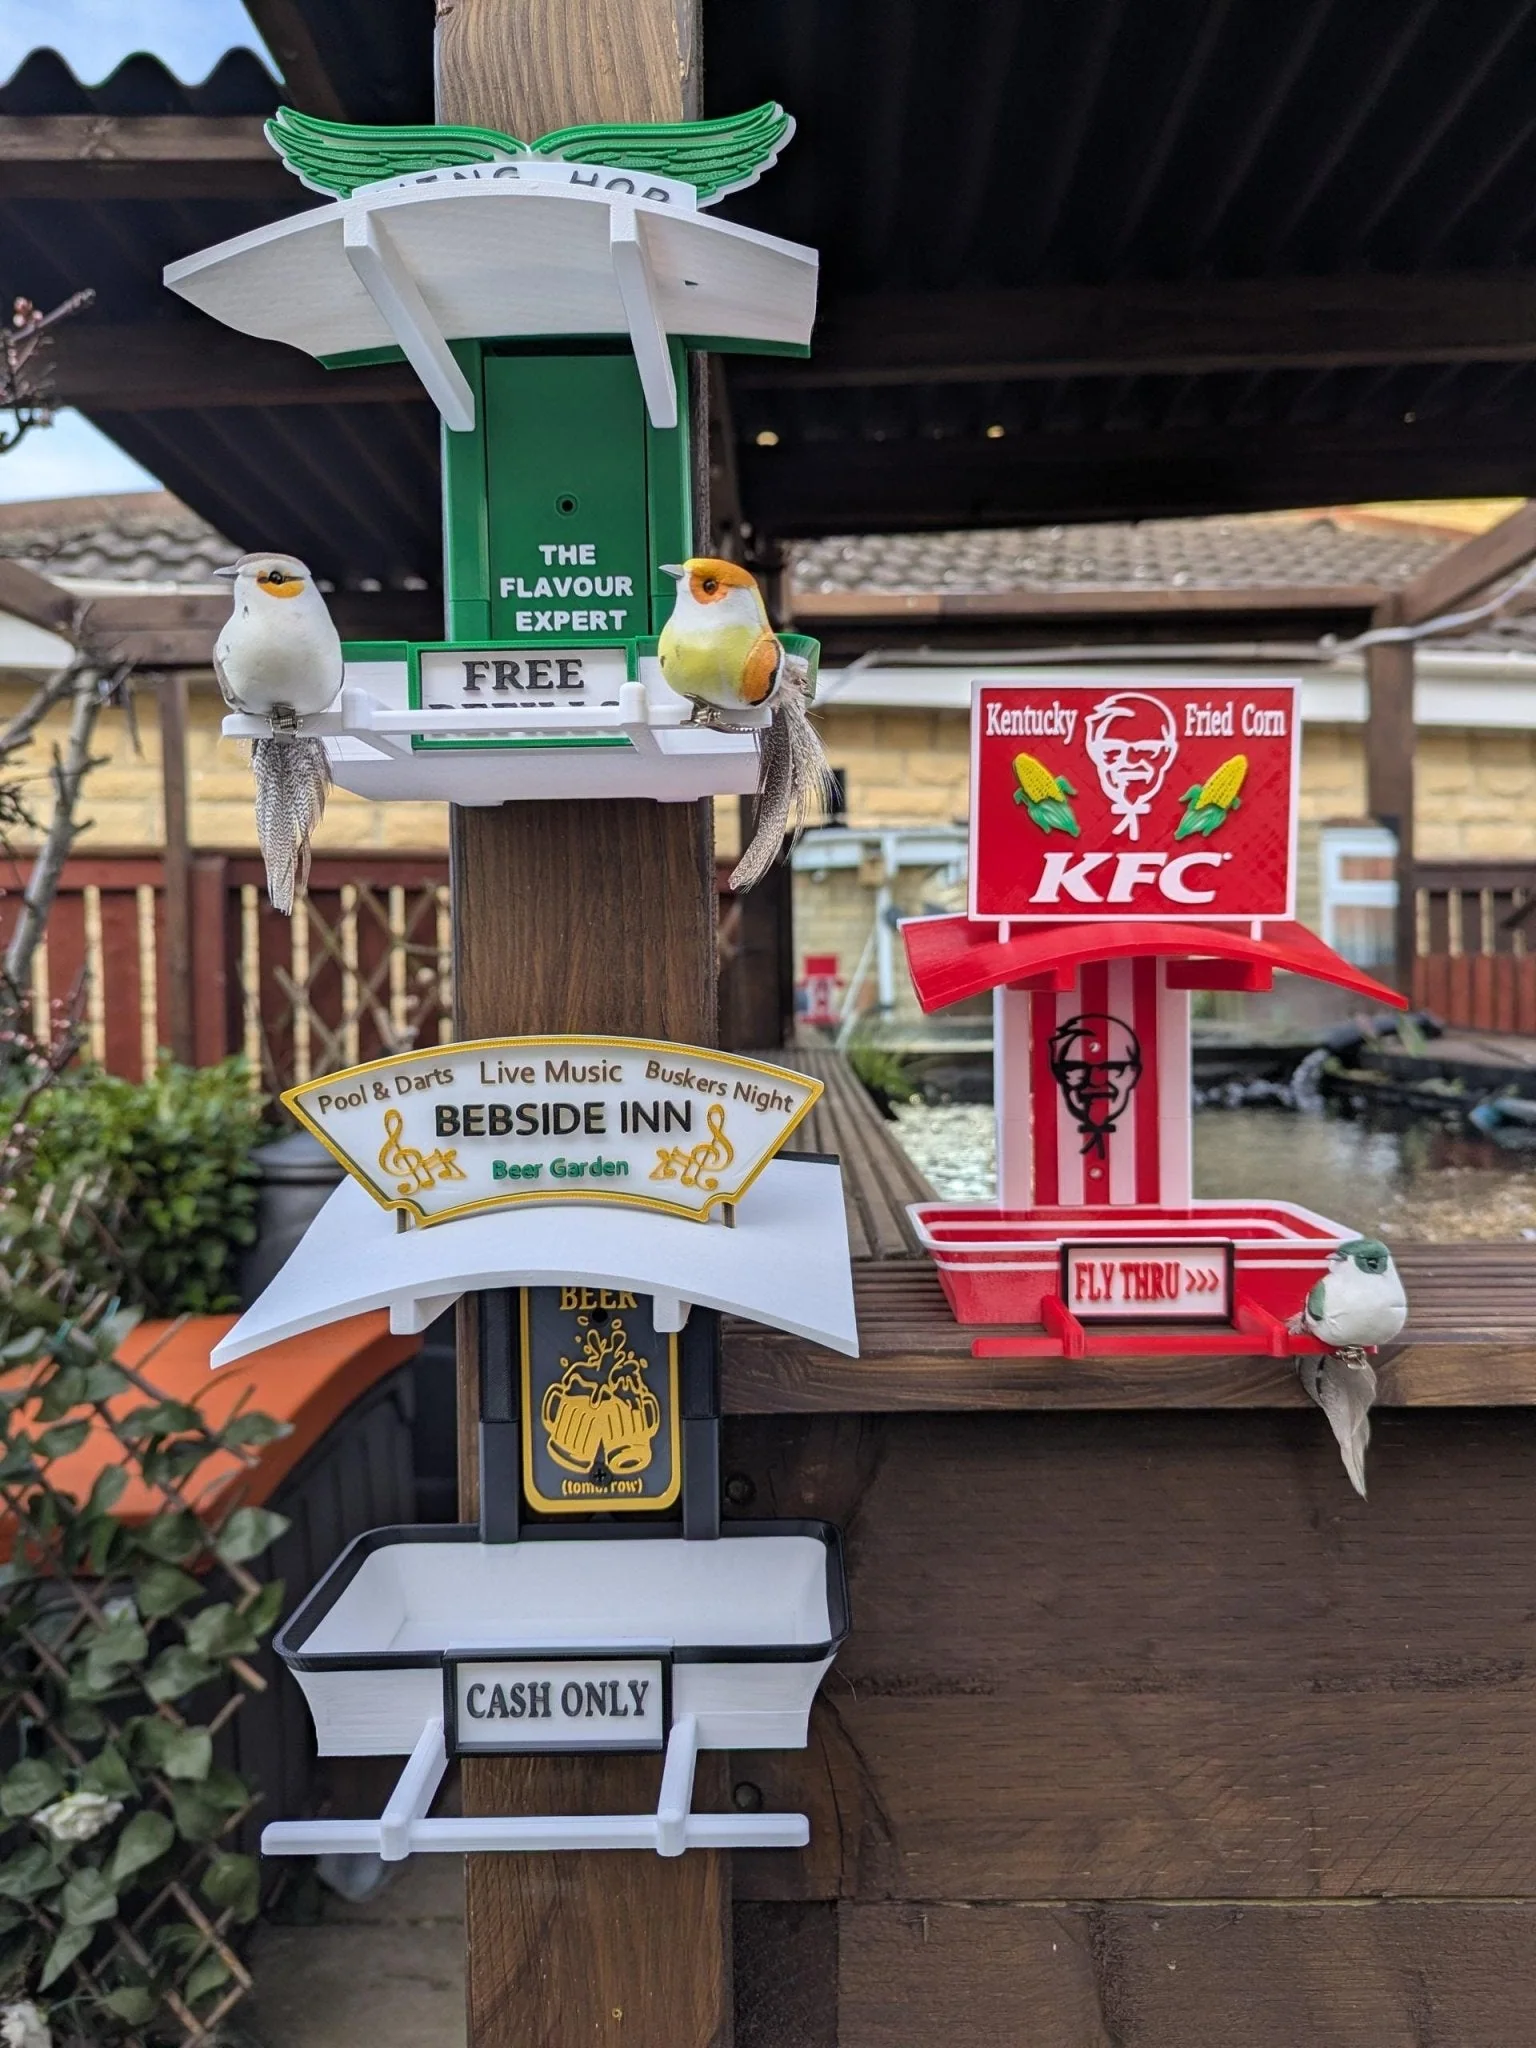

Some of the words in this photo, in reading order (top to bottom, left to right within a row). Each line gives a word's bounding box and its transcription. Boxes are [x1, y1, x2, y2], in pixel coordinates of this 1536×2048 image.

[538, 544, 596, 566] THE
[500, 576, 633, 598] FLAVOUR
[515, 610, 627, 632] EXPERT
[462, 659, 585, 691] FREE
[986, 701, 1077, 745] Kentucky
[1184, 702, 1234, 737] Fried
[1242, 703, 1286, 737] Corn
[1029, 852, 1222, 904] KFC
[318, 1084, 368, 1114] Pool
[372, 1081, 391, 1101] &
[395, 1068, 453, 1096] Darts
[480, 1061, 535, 1084] Live
[545, 1059, 622, 1084] Music
[645, 1060, 728, 1096] Buskers
[733, 1081, 794, 1112] Night
[435, 1102, 606, 1137] BEBSIDE
[620, 1100, 691, 1134] INN
[492, 1159, 543, 1180] Beer
[549, 1155, 629, 1178] Garden
[560, 1287, 638, 1310] BEER
[1075, 1262, 1115, 1301] FLY
[1119, 1262, 1180, 1300] THRU
[466, 1682, 552, 1718] CASH
[561, 1680, 649, 1717] ONLY
